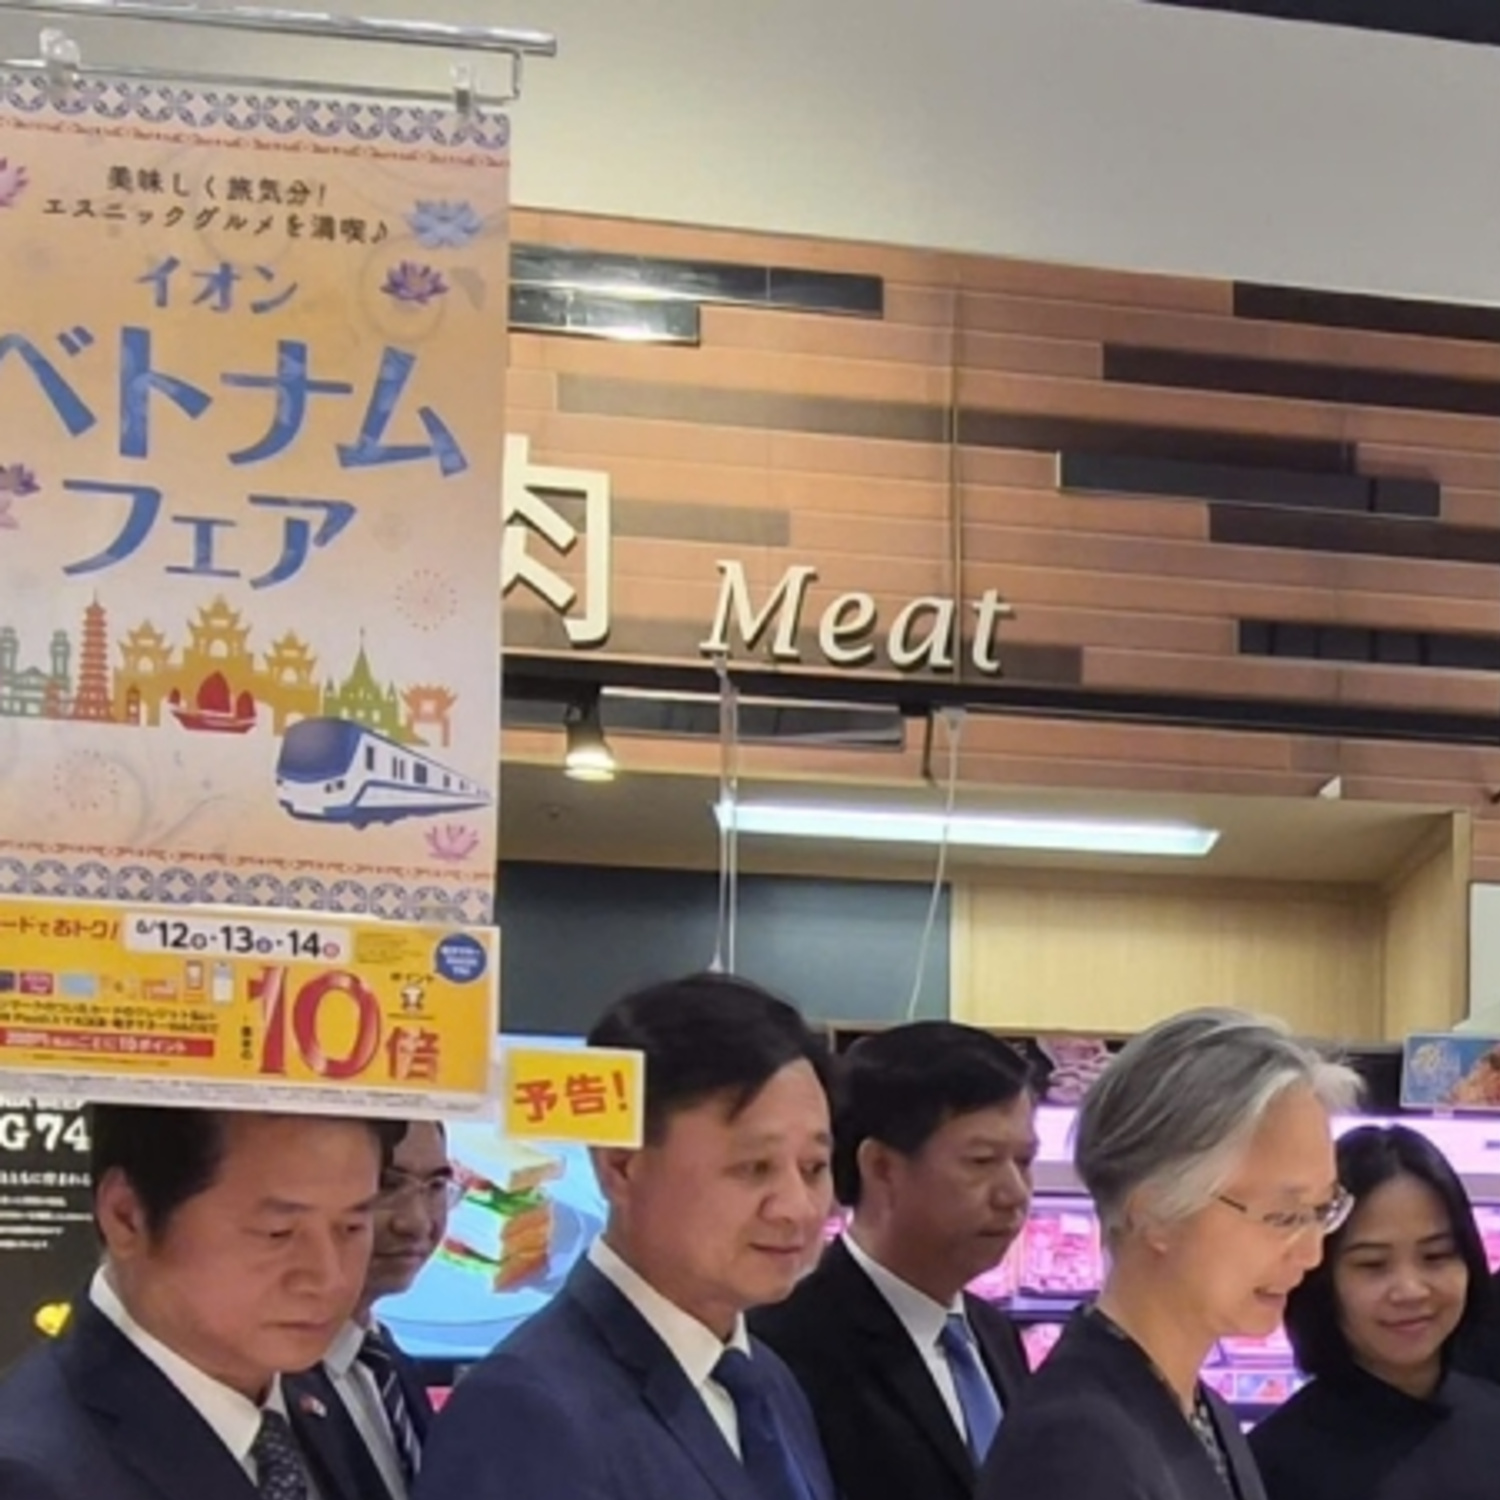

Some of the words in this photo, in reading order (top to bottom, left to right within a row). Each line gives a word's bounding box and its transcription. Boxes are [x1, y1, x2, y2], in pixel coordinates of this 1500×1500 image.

[107, 165, 326, 206] 美味しく旅気分!
[136, 256, 298, 314] イオン
[0, 325, 469, 478] ベトナム
[62, 479, 357, 589] フェア
[699, 559, 1014, 672] Meat
[516, 1072, 629, 1123] 予告!
[34, 1114, 92, 1152] 74
